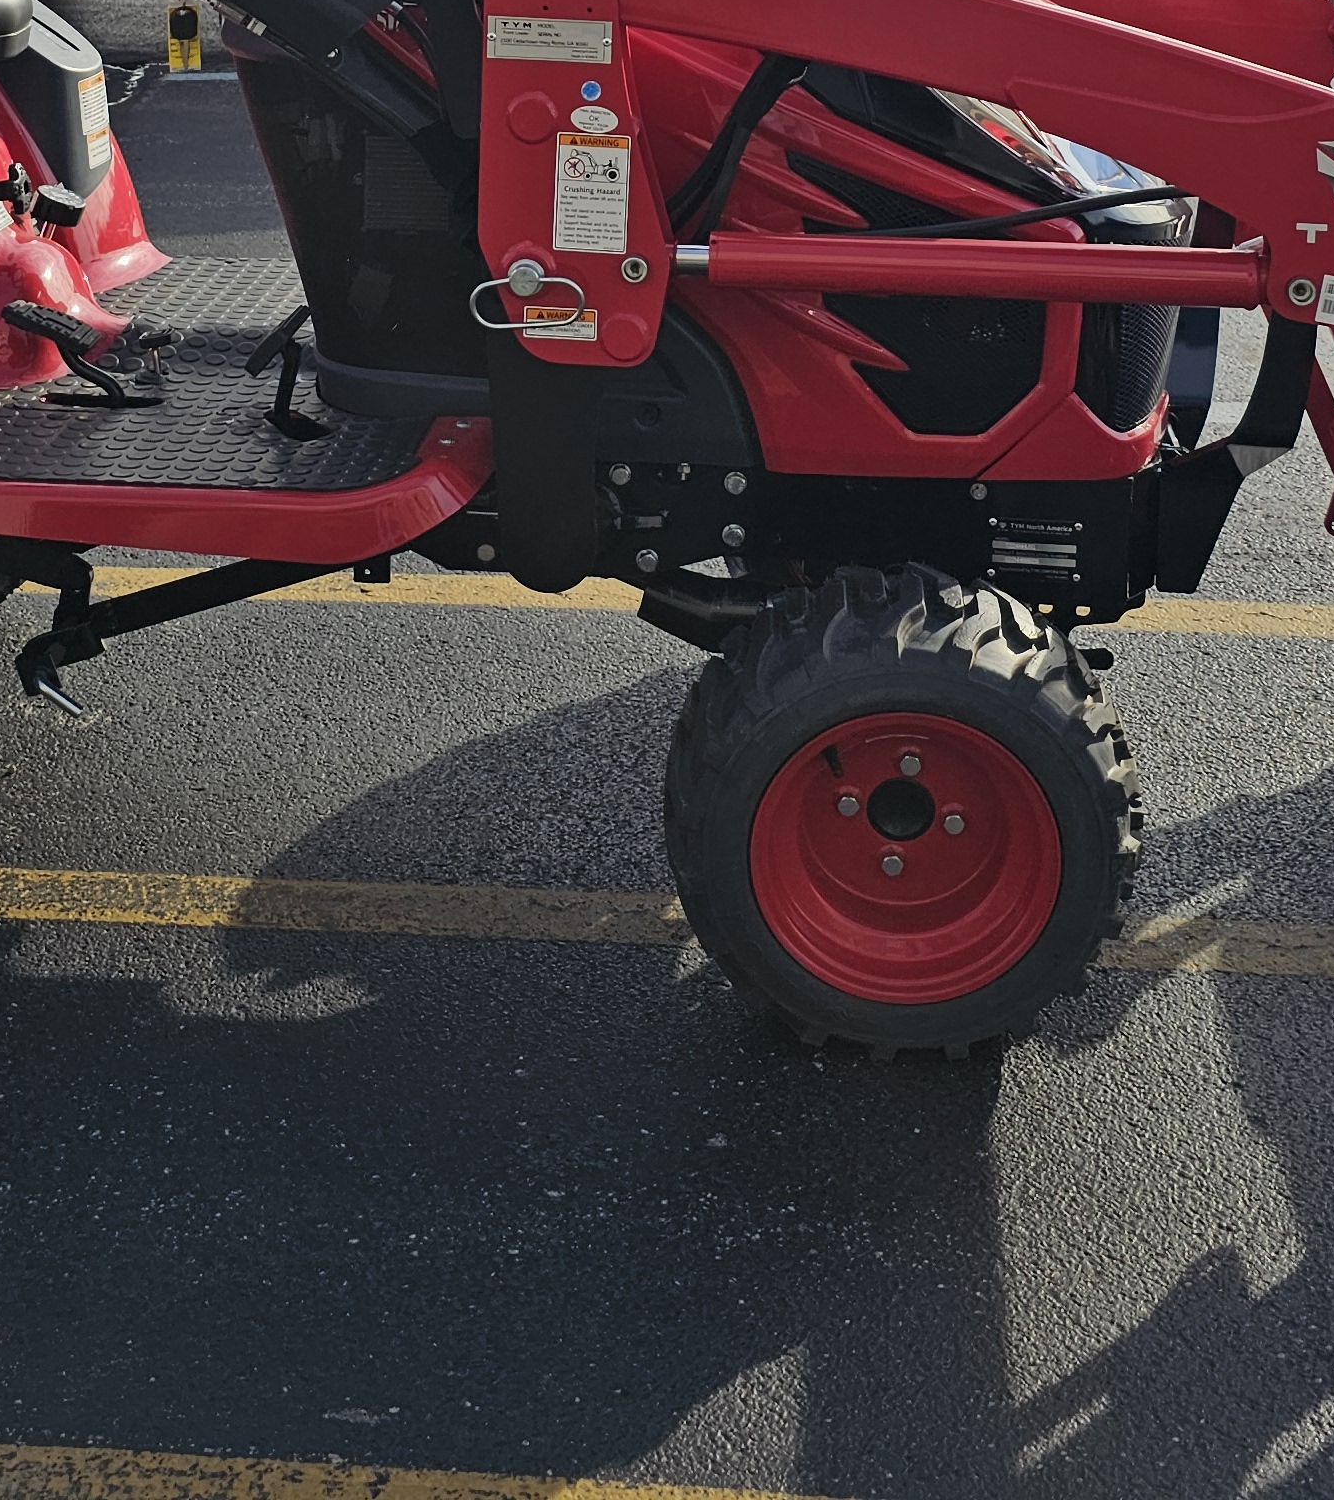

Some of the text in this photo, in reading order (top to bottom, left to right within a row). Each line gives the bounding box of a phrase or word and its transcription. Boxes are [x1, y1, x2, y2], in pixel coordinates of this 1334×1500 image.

[580, 137, 619, 147] WARNING
[564, 186, 594, 195] Crushing
[546, 312, 585, 320] WARNG
